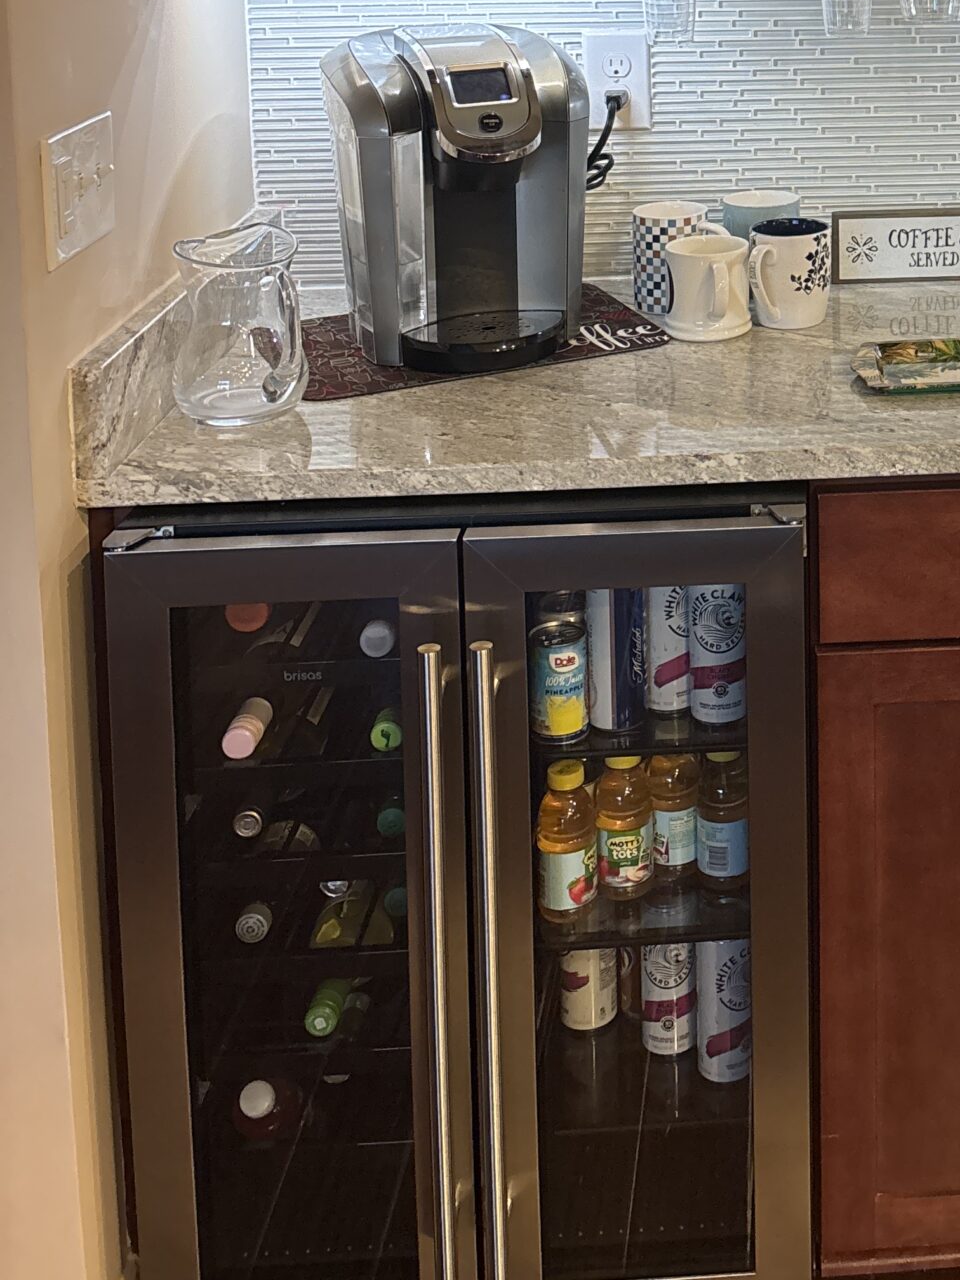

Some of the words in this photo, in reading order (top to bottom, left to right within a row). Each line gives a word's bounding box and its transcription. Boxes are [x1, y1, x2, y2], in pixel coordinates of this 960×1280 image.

[888, 227, 956, 248] COFFEE
[909, 251, 960, 267] SERVED
[556, 323, 663, 351] offee
[692, 592, 710, 627] WHITE
[699, 635, 722, 651] HARD
[554, 655, 576, 668] Dole
[545, 675, 565, 687] 100%
[648, 971, 670, 986] HARD
[715, 955, 738, 994] WHITE
